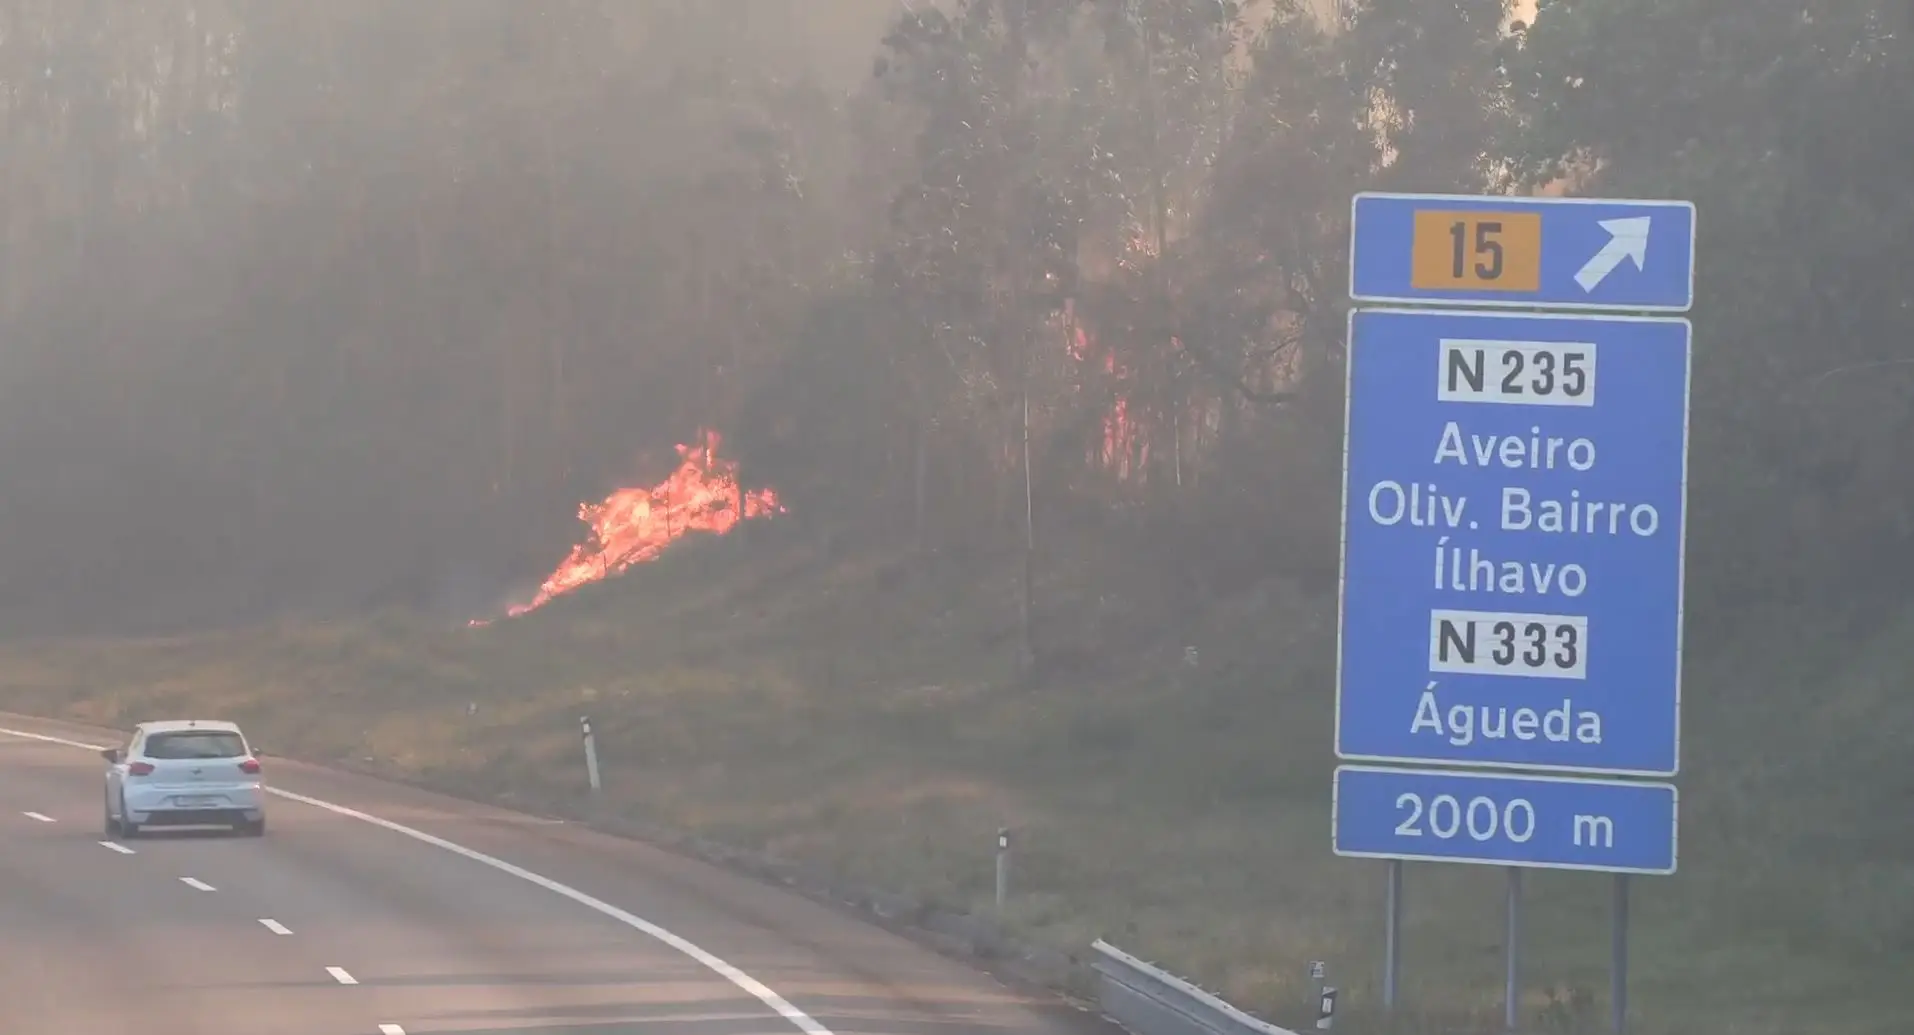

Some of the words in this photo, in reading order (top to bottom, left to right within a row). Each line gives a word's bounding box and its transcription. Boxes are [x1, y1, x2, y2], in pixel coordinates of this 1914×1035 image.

[1450, 222, 1503, 280] 15
[1447, 349, 1486, 393] N
[1501, 350, 1586, 397] 235
[1434, 421, 1595, 471] Aveiro
[1368, 480, 1478, 529] Oliv.
[1501, 487, 1658, 536] Bairro
[1435, 536, 1587, 597] Ílhavo
[1438, 620, 1476, 664] N
[1492, 621, 1577, 669] 333
[1410, 681, 1602, 746] Águeda
[1394, 793, 1535, 842] 2000
[1573, 814, 1613, 847] m
